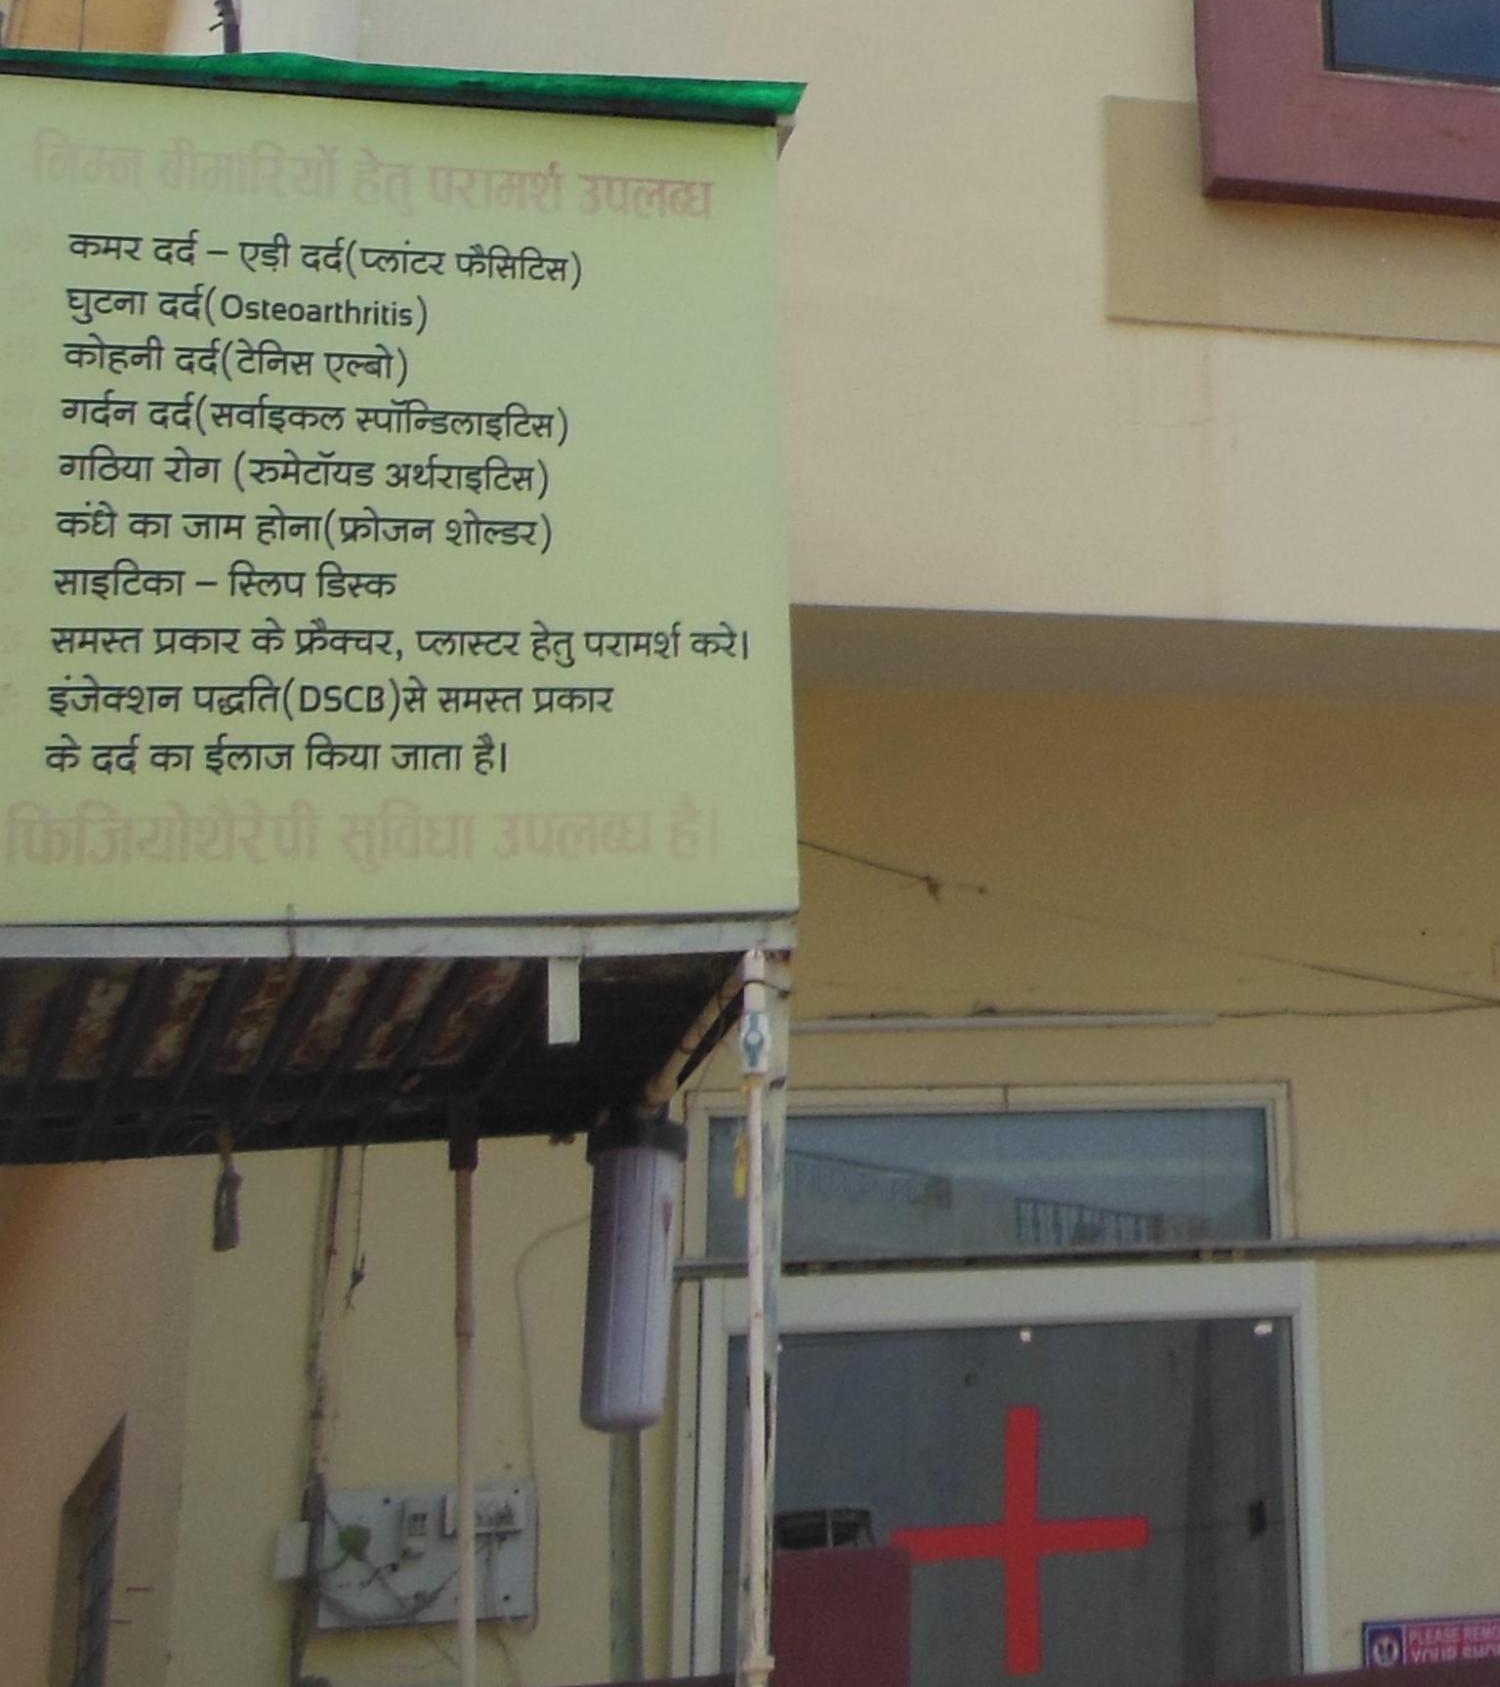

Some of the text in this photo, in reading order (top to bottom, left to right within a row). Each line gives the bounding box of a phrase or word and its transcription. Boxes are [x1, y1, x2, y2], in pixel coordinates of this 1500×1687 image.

[428, 161, 563, 213] परामर्श
[68, 234, 143, 260] कमर
[152, 229, 199, 265] दर्द
[238, 232, 291, 272] एड़ी
[66, 288, 149, 324] घुटना
[63, 332, 165, 375] कोहनी
[324, 343, 407, 388] एल्बो)
[61, 388, 138, 427] गर्दन
[58, 443, 154, 482] गठिया
[164, 446, 222, 484] रोग
[385, 454, 548, 500] अर्थराइटिस)
[56, 500, 118, 538] कंधे
[128, 513, 172, 538] का
[182, 514, 246, 540] जाम
[445, 509, 551, 555] शोल्डर)
[54, 558, 186, 599] साइटिका
[228, 560, 306, 598] स्लिप
[316, 561, 397, 599] डिस्क
[51, 627, 143, 654] समस्त
[153, 628, 241, 655] प्रकार
[252, 617, 285, 654] के
[416, 631, 521, 656] प्लास्टर
[530, 621, 575, 667] हेतु
[584, 622, 680, 659] परामर्श
[48, 675, 182, 716] इंजेक्शन
[437, 687, 523, 714] समस्त
[533, 687, 613, 714] प्रकार
[45, 733, 81, 772] के
[91, 733, 140, 774] दर्द
[150, 745, 193, 771] का
[204, 733, 294, 777] ईलाज
[305, 732, 380, 771] किया
[391, 744, 462, 771] जाता
